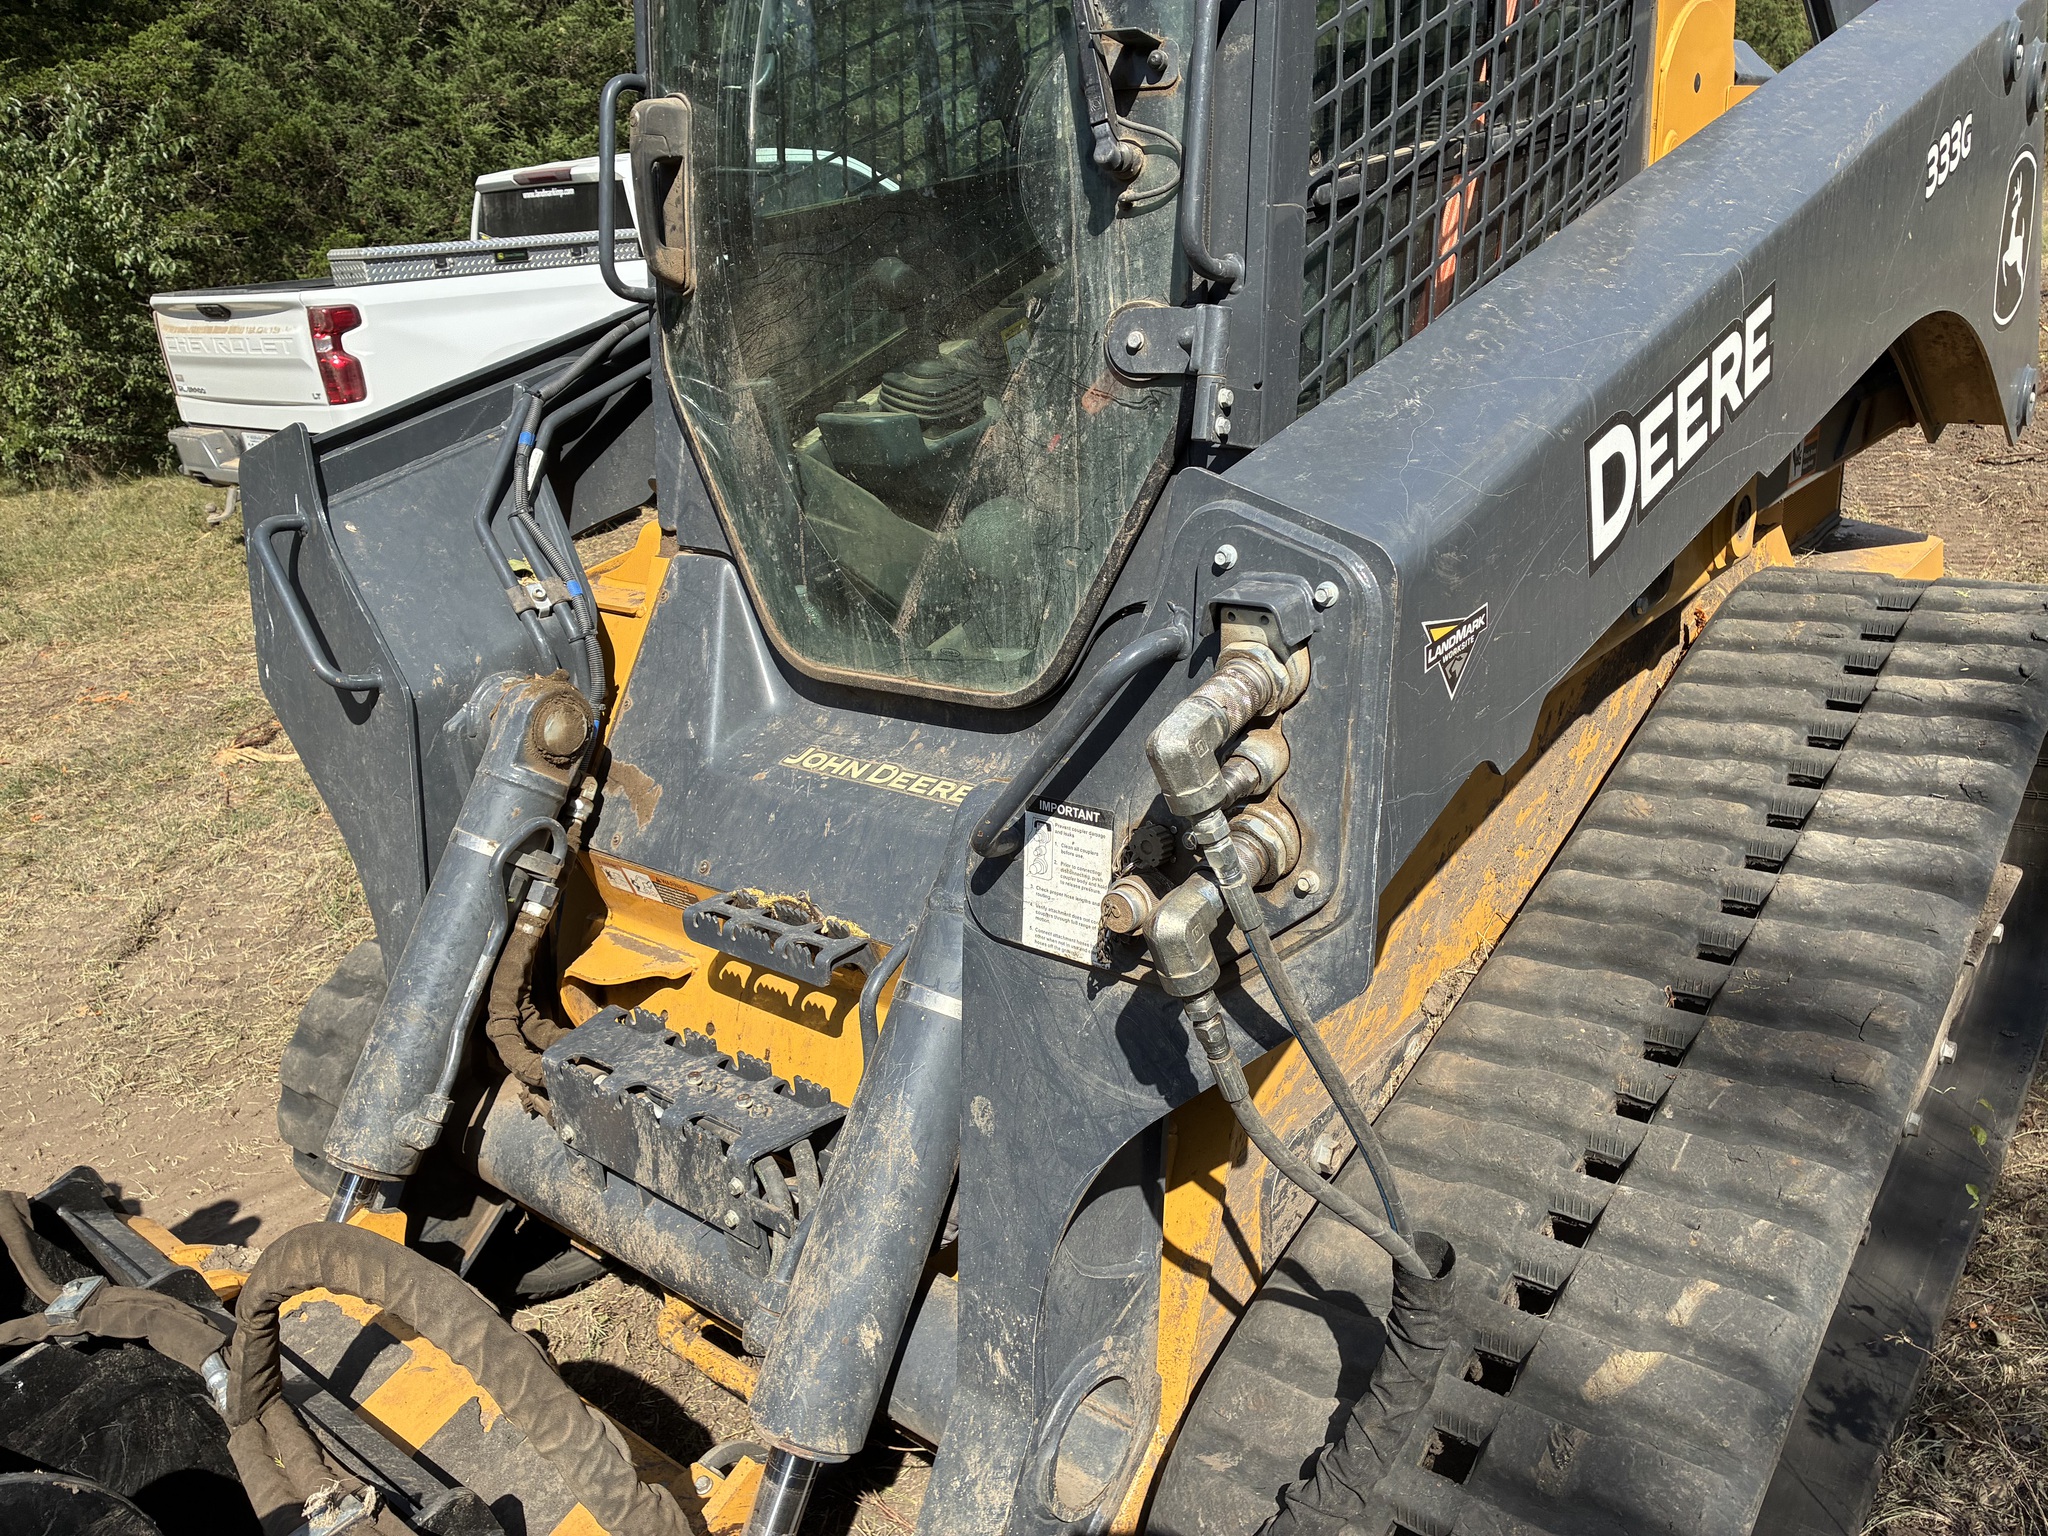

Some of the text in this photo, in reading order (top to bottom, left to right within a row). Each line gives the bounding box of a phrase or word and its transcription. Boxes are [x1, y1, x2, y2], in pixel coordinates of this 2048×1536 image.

[1925, 113, 1972, 199] 333G
[164, 336, 293, 355] CHEVROLET
[1589, 295, 1772, 561] DEERE
[1428, 613, 1486, 664] LANDMARK
[1442, 634, 1475, 663] WORKSITE
[783, 747, 974, 803] JOHN DEERE
[1039, 799, 1101, 823] IMPORTANT
